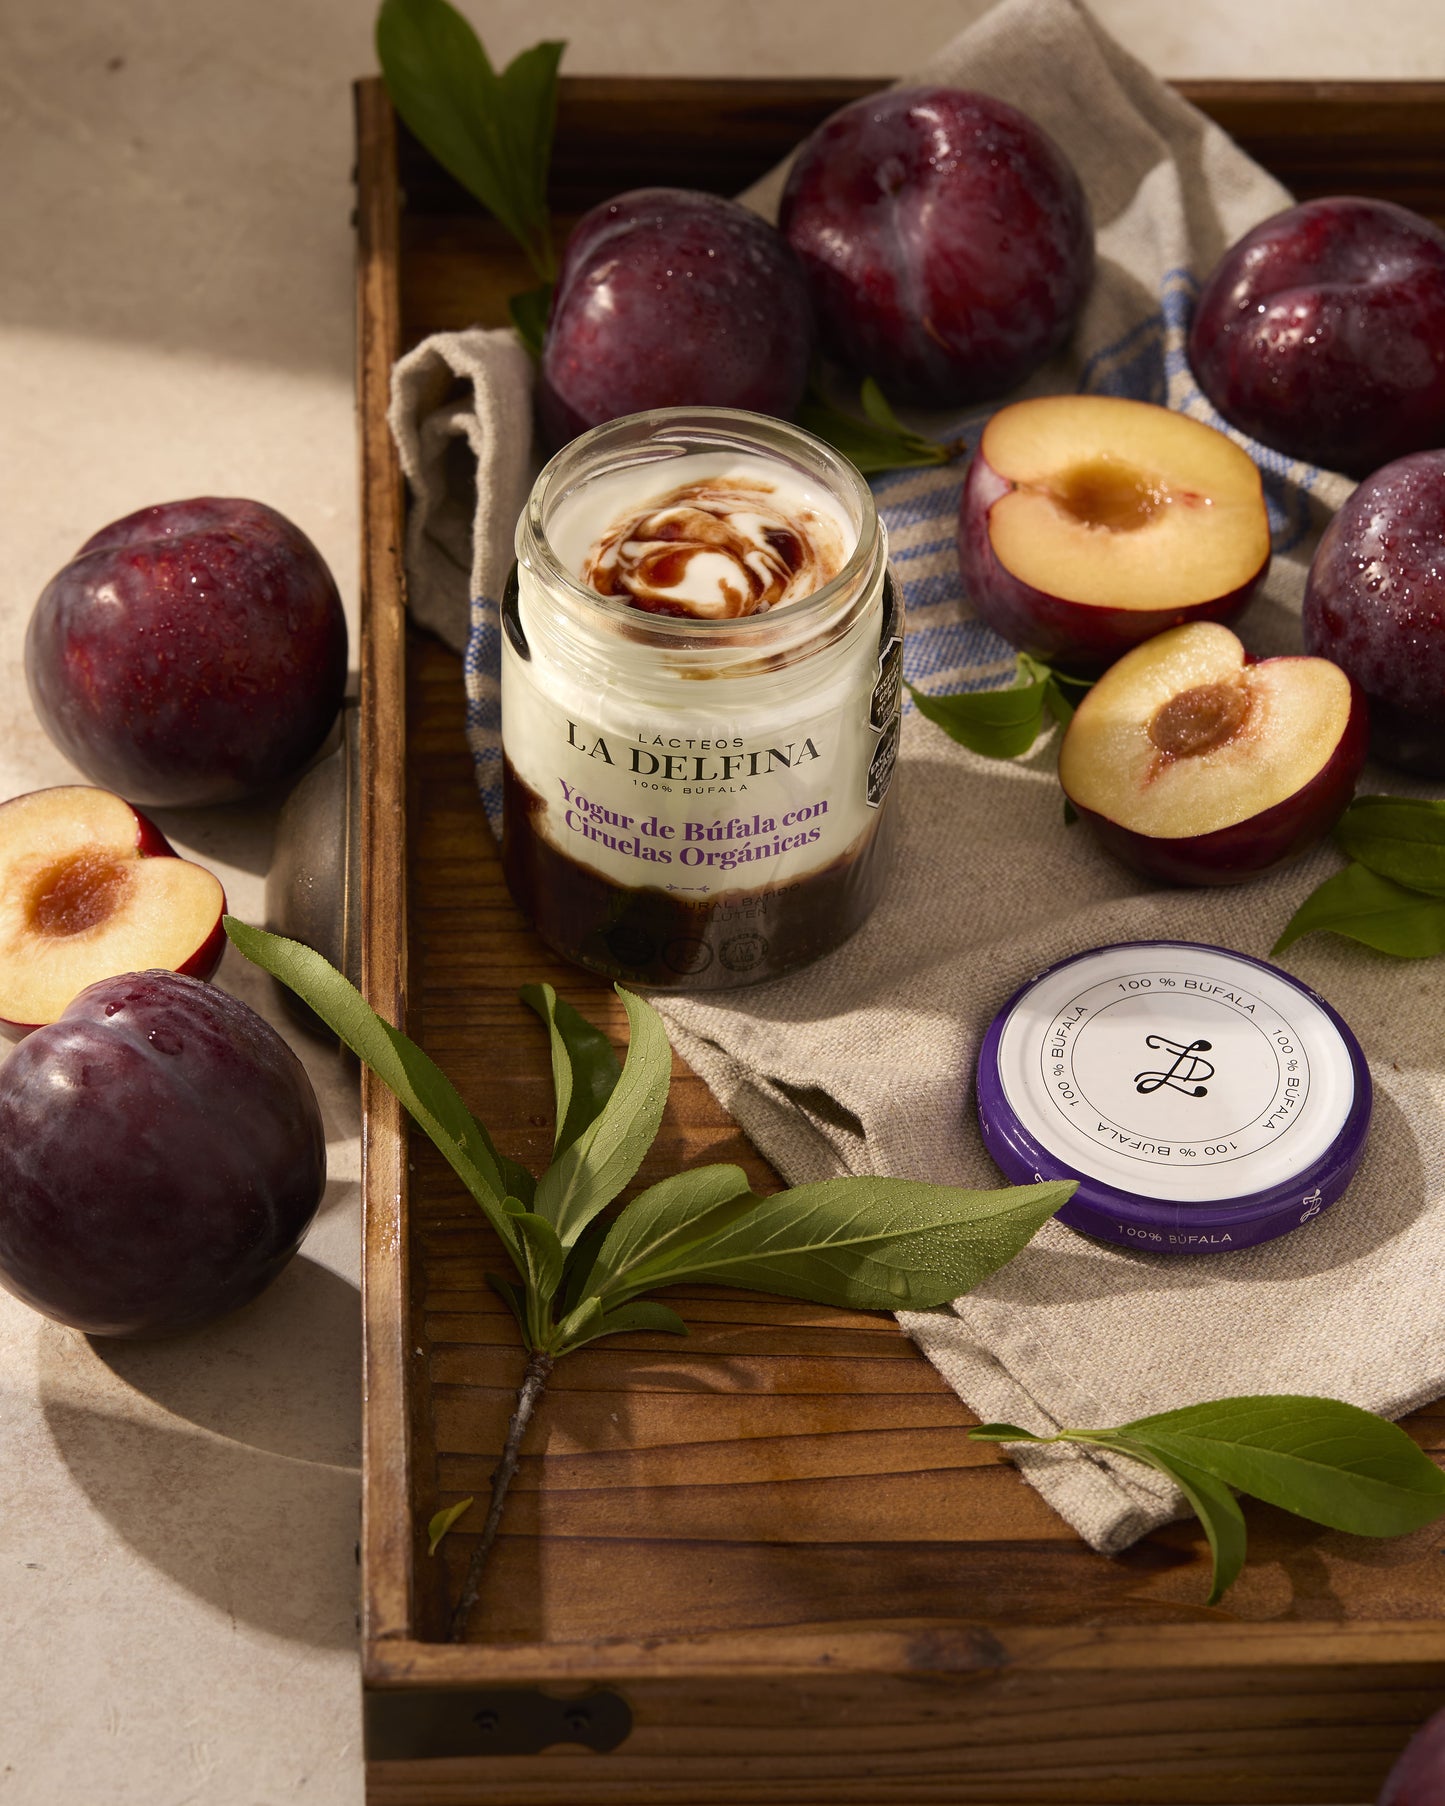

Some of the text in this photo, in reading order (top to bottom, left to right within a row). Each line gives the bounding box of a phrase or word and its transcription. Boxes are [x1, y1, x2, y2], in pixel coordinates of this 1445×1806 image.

[566, 719, 821, 781] LA DELFINA
[639, 733, 744, 750] LÁCTEOS
[633, 779, 748, 795] 100% BÚFALA
[558, 776, 829, 842] Yogur de Búfala con
[565, 808, 822, 871] Ciruelas Orgánicas
[651, 882, 801, 911] TURAL BATIDO
[1118, 977, 1257, 1014] 100 % BÚFALA
[1051, 1005, 1088, 1107] 100 % BÚFALA
[1262, 1028, 1300, 1130] 100 % BÚFALA
[1097, 1121, 1238, 1157] 100 % BÚFALA
[1118, 1225, 1233, 1245] 100% BÚFALA
